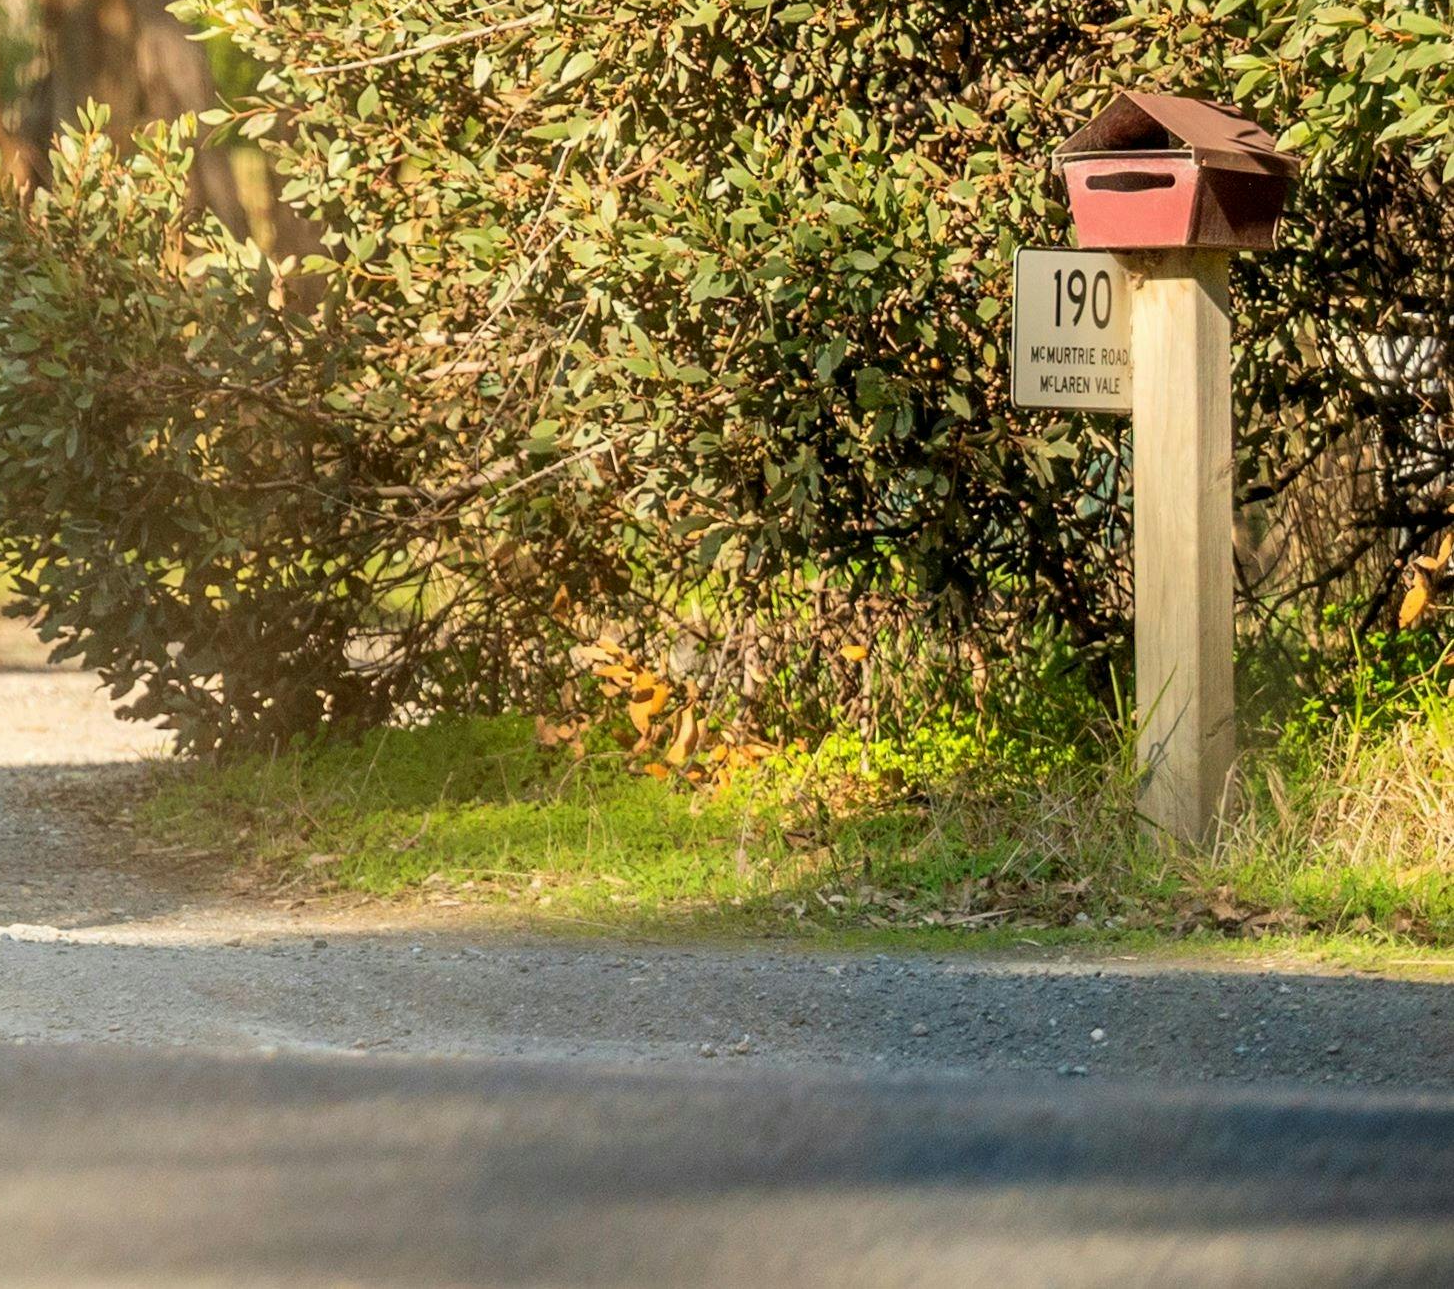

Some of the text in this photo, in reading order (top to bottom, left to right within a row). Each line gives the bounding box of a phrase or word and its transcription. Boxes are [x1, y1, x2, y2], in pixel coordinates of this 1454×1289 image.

[1054, 269, 1112, 330] 190
[1101, 348, 1129, 366] ROAD
[1095, 376, 1120, 395] VALE
